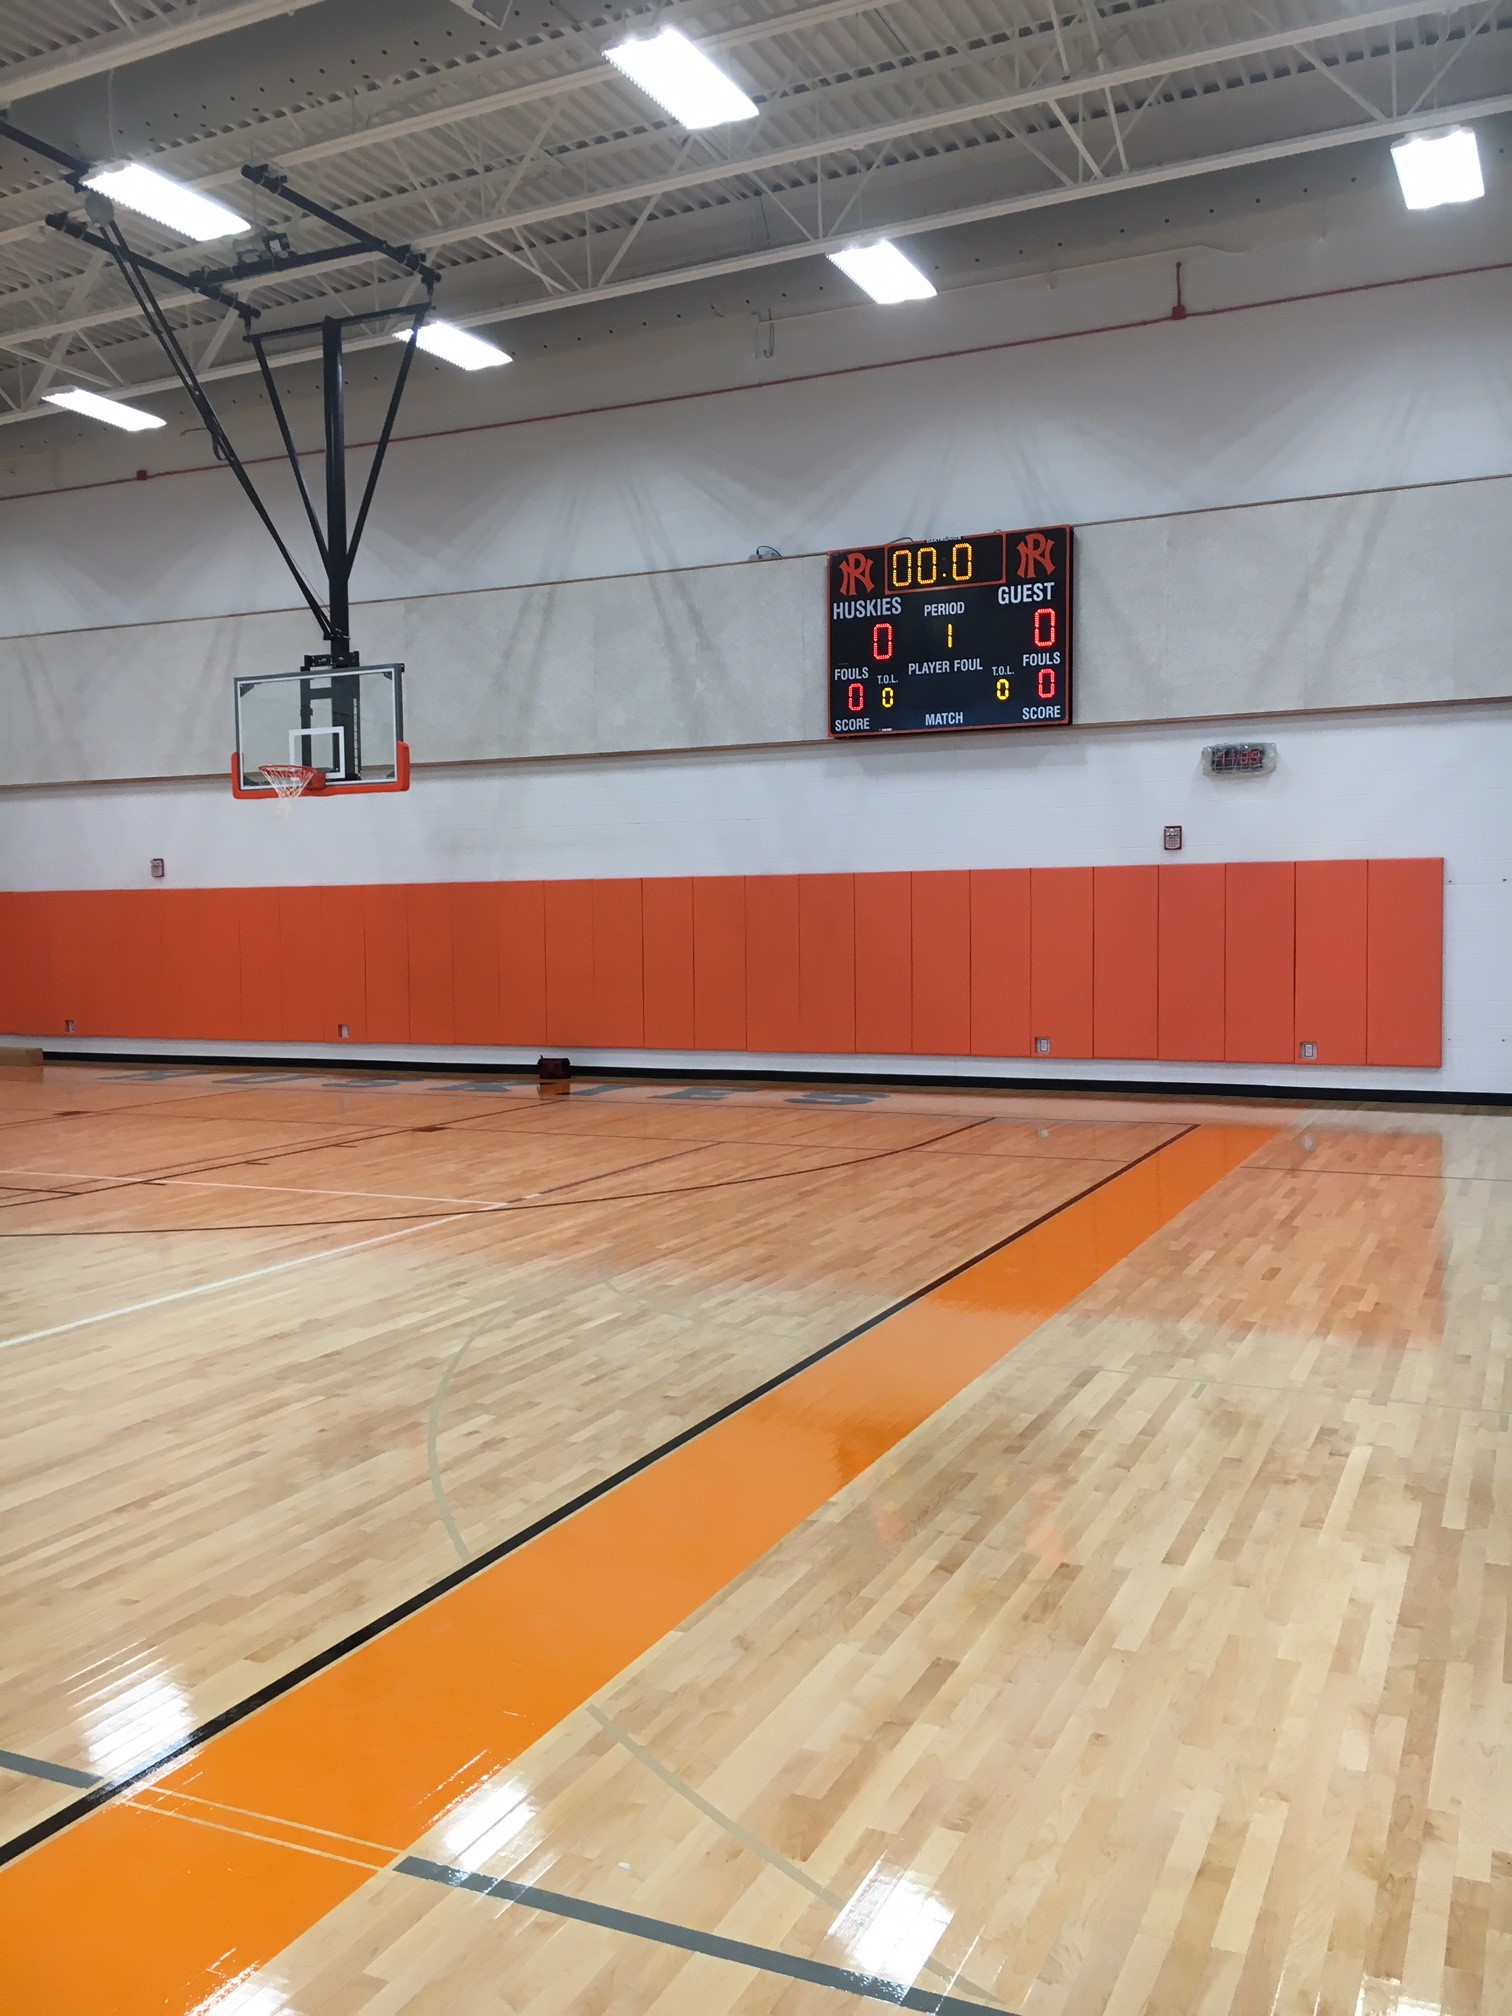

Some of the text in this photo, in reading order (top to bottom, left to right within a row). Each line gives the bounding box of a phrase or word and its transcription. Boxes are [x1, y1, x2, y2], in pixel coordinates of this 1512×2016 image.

[998, 582, 1055, 604] GUEST
[833, 597, 902, 620] HUSKIES
[924, 602, 965, 616] PERIOD
[947, 623, 953, 648] 1
[1034, 608, 1056, 647] 0
[873, 623, 893, 660] 0
[908, 658, 983, 675] PLAYER FOUL
[1023, 652, 1061, 667] FOULS
[834, 667, 869, 681] FOULS
[1038, 668, 1055, 698] 0
[848, 683, 864, 711] 0
[882, 687, 894, 708] 0
[996, 678, 1009, 700] 0
[925, 712, 963, 726] MATCH
[1022, 705, 1061, 720] SCORE
[835, 717, 870, 732] SCORE
